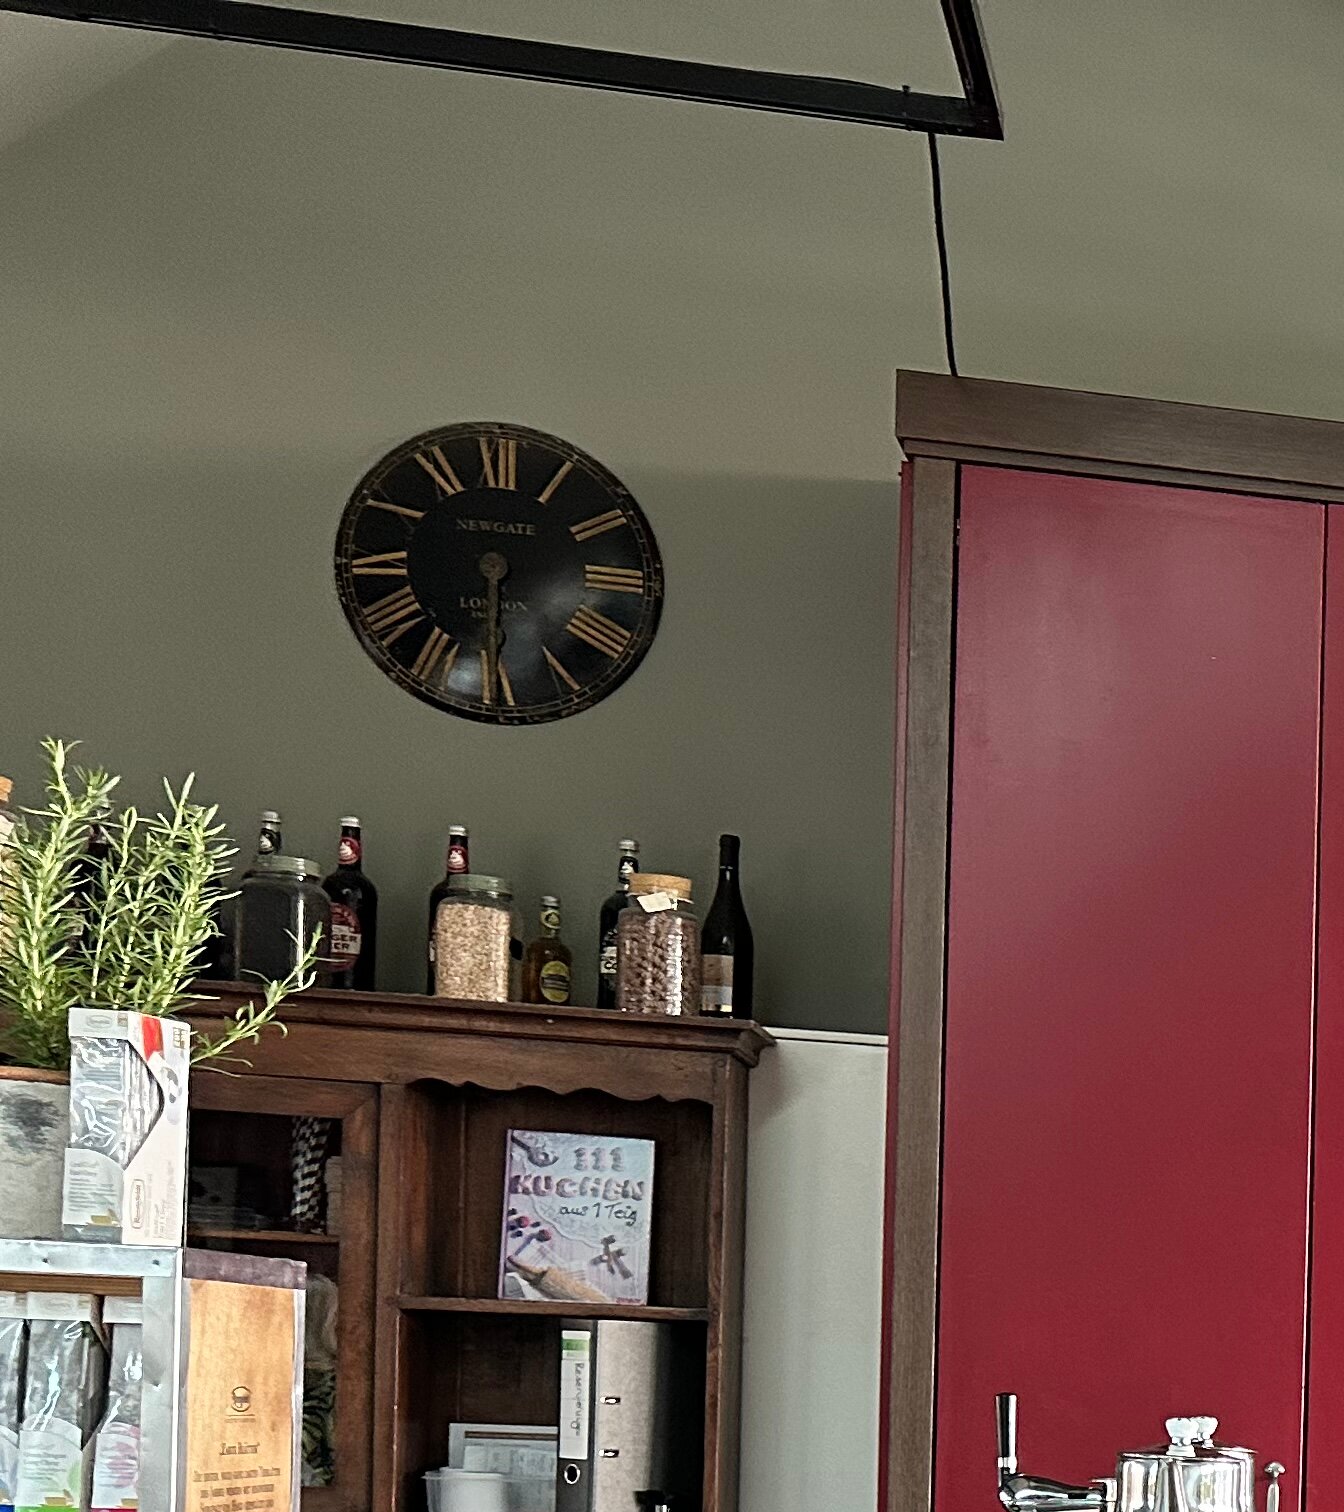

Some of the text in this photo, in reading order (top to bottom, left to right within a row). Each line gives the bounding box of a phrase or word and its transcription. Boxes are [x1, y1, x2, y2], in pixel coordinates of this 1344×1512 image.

[456, 518, 537, 536] NEWGATE
[460, 597, 528, 611] LOON
[508, 1173, 646, 1202] KUCHEN
[559, 1206, 589, 1217] aus
[604, 1201, 638, 1228] Teig
